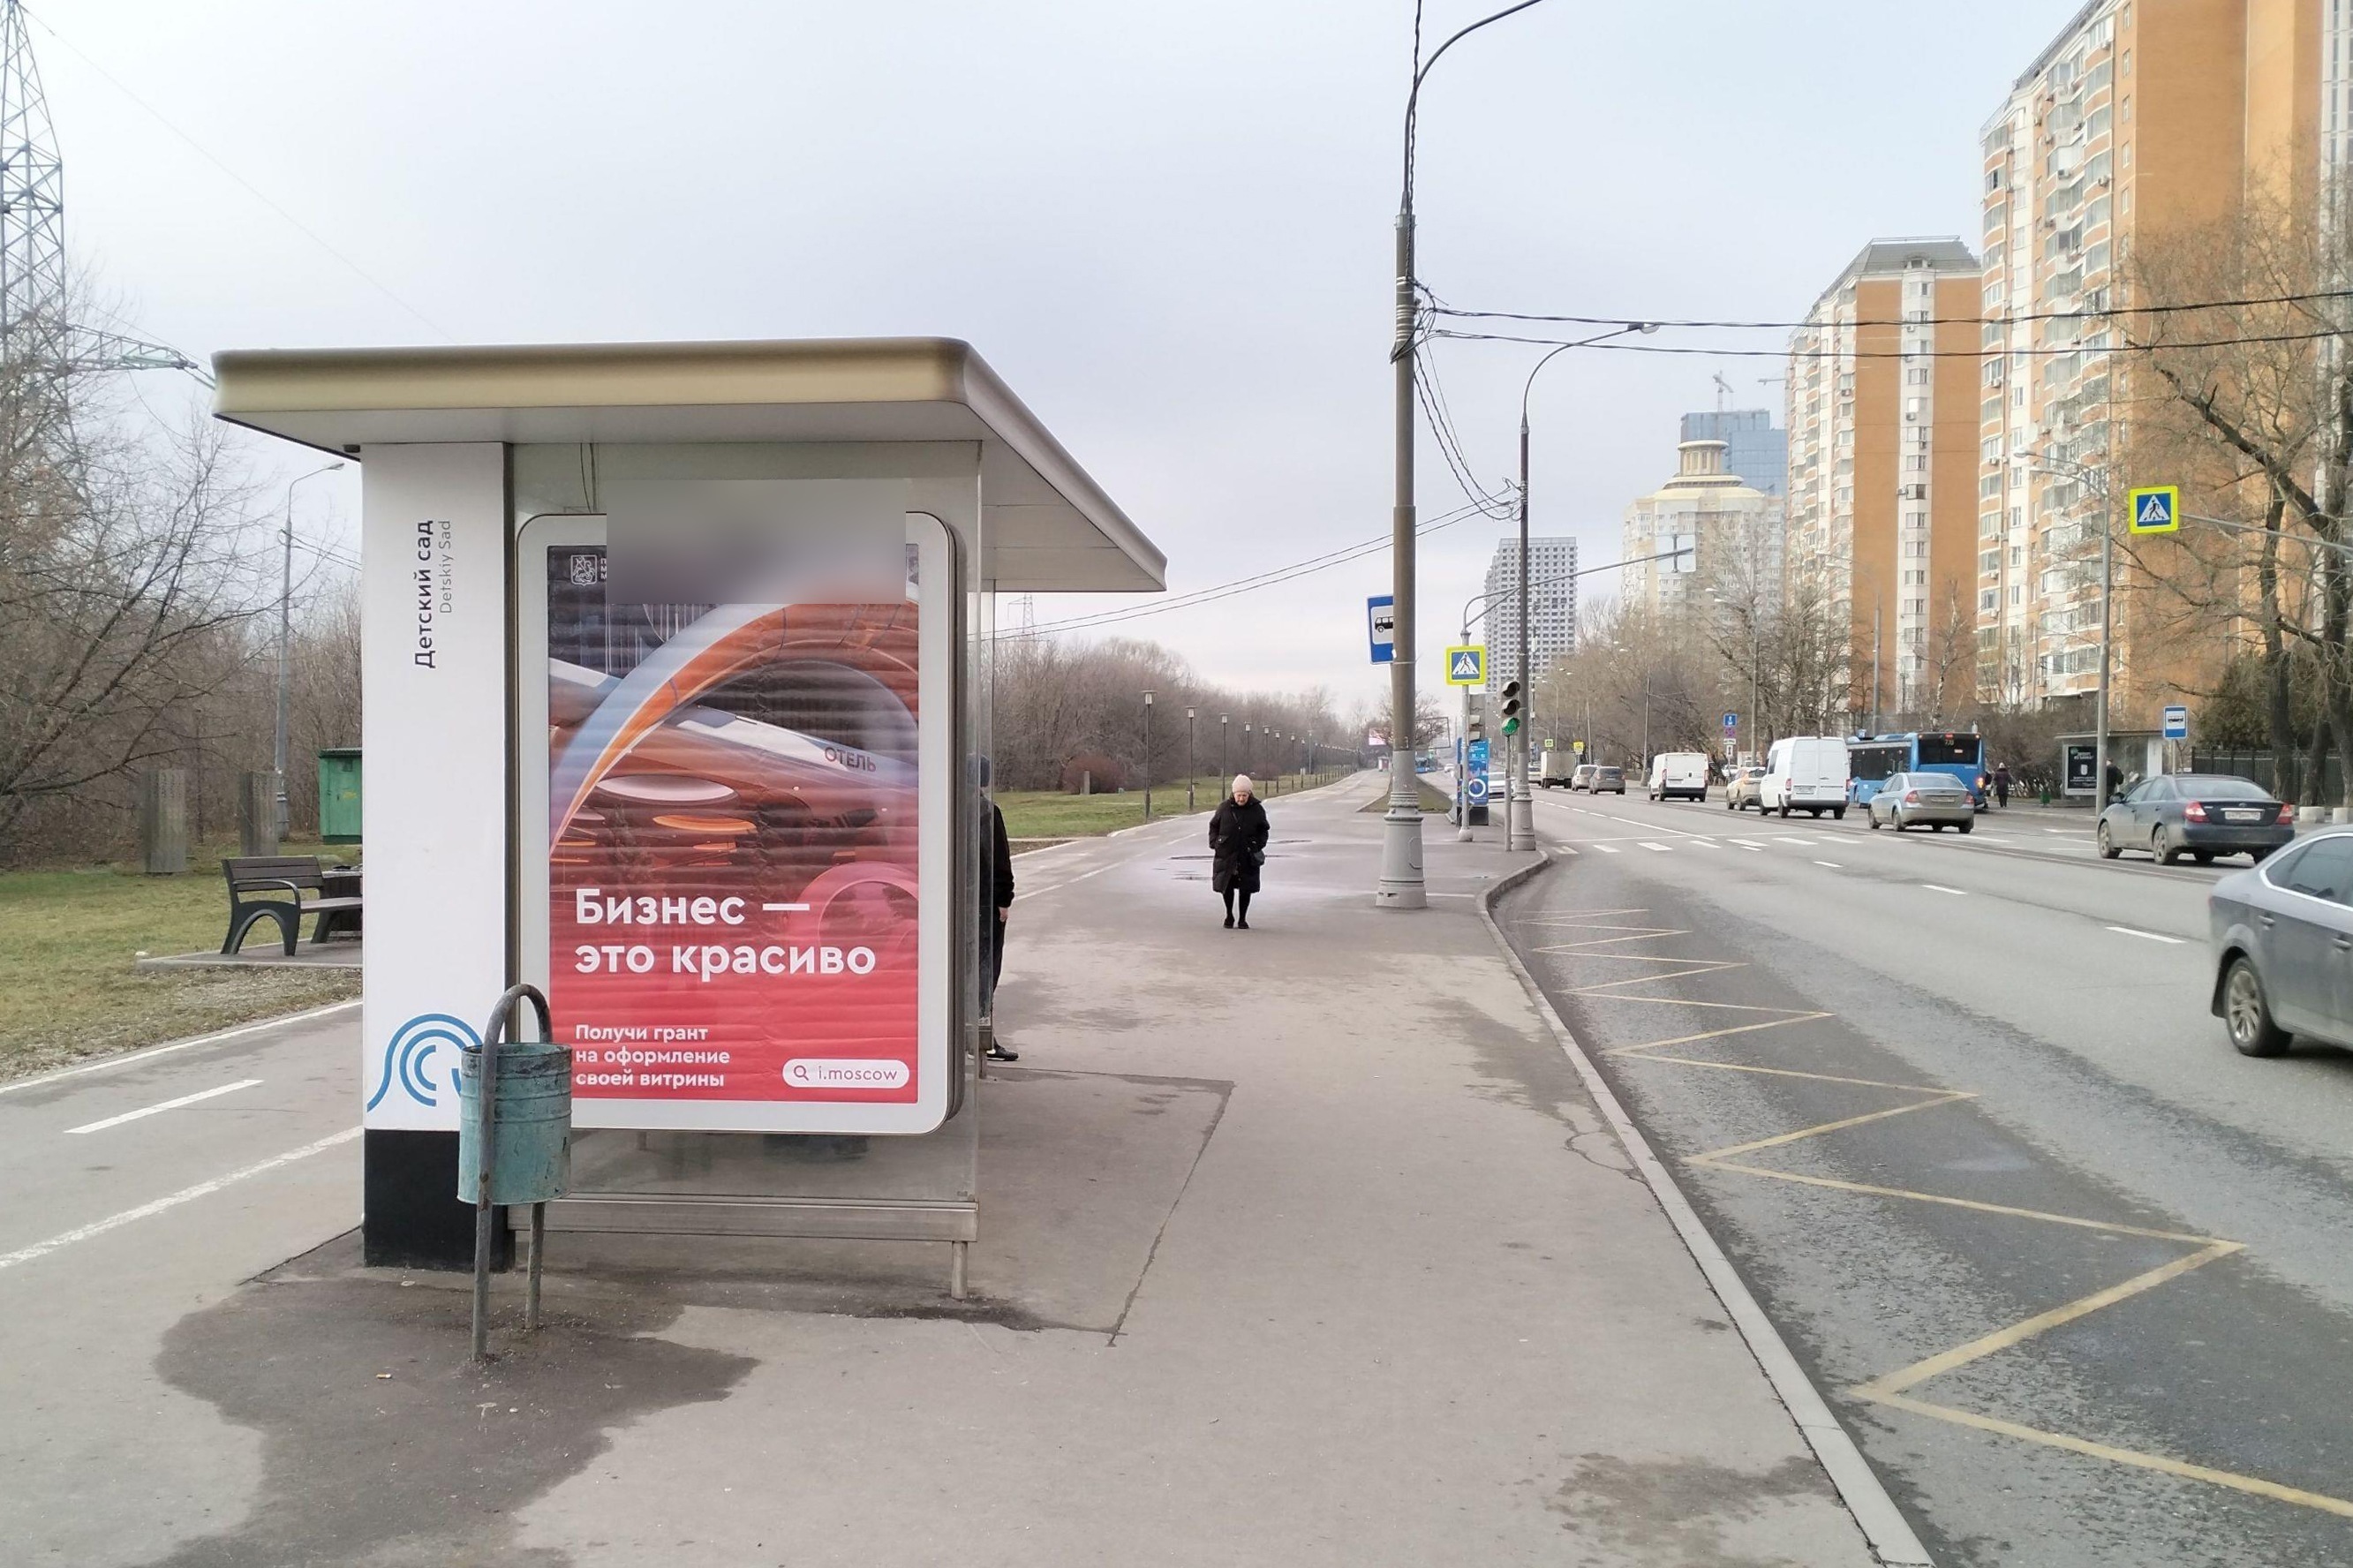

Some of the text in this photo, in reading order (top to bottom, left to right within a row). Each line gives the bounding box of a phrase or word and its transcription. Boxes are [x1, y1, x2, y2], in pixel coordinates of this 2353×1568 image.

[438, 520, 454, 614] Detskiy Sad
[413, 520, 436, 669] Детский сад
[825, 746, 876, 773] ОТЕЛЬ
[576, 888, 745, 925] Бизнес
[575, 945, 876, 983] это красиво
[576, 1024, 708, 1043] Получи грант
[576, 1045, 731, 1067] на оформление
[576, 1068, 725, 1089] своей витрины
[818, 1065, 898, 1081] i.moscow
